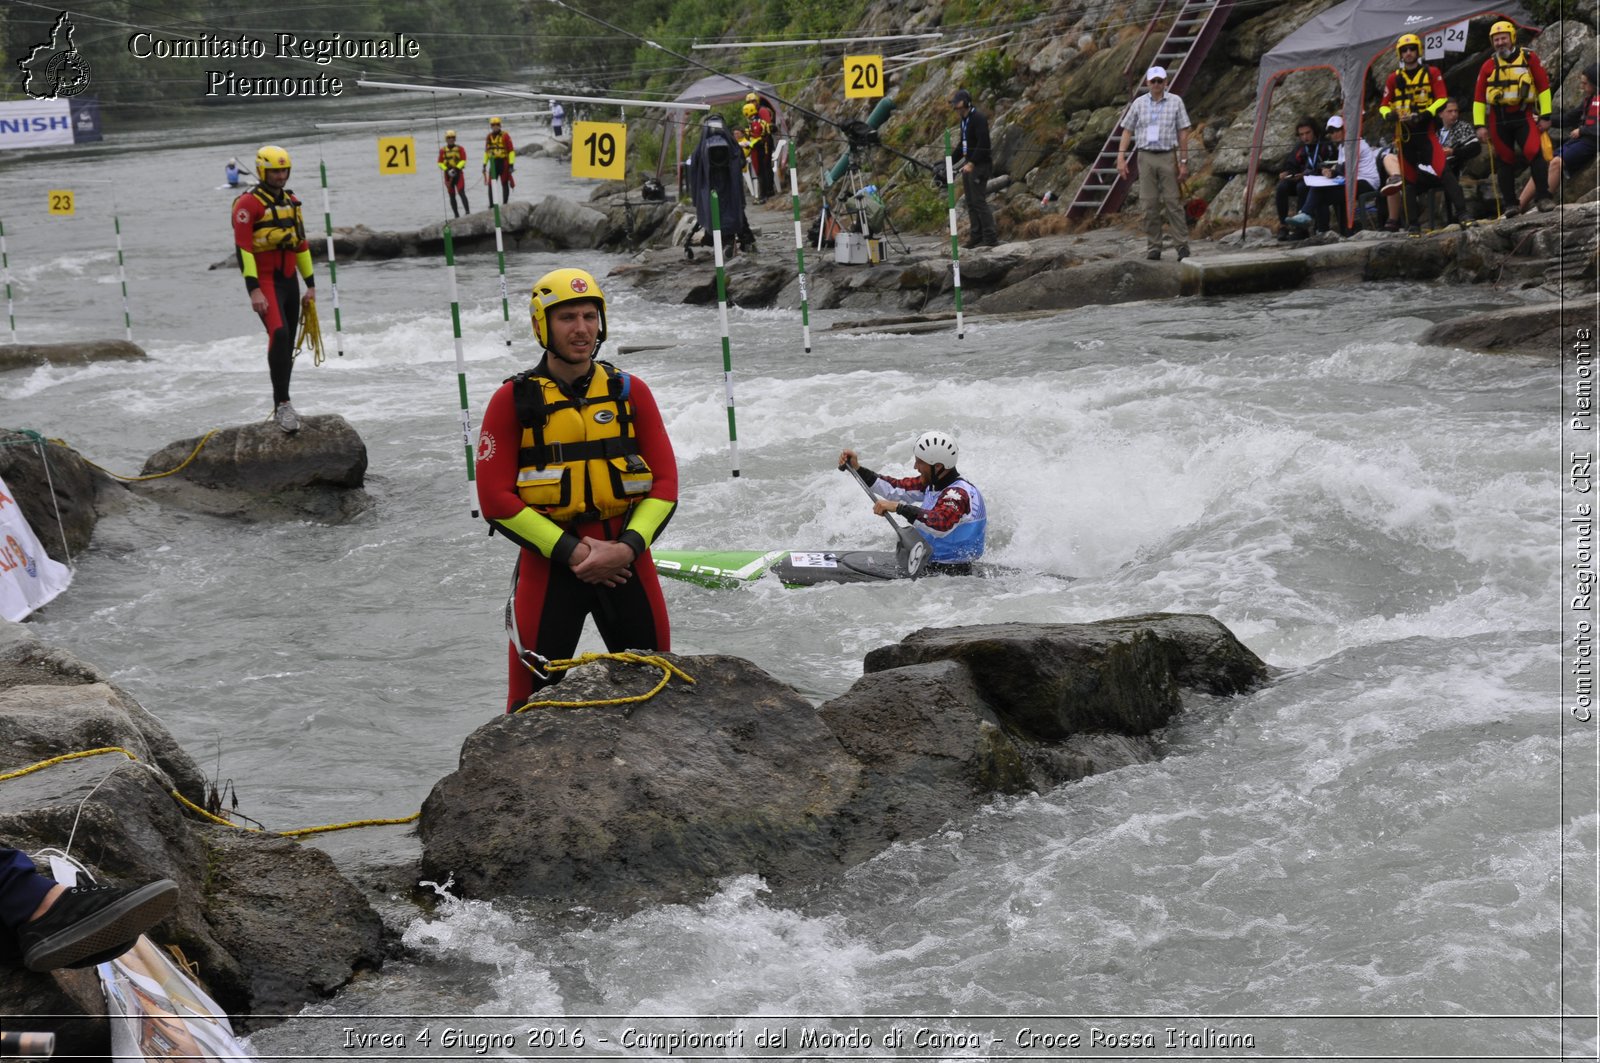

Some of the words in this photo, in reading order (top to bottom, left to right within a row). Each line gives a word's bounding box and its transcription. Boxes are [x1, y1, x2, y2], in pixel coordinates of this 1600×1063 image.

[1426, 35, 1443, 50] 23
[1446, 28, 1464, 42] 24
[851, 63, 878, 89] 20
[0, 115, 68, 134] NISH
[386, 144, 410, 168] 21
[584, 132, 616, 167] 19
[52, 195, 72, 210] 23
